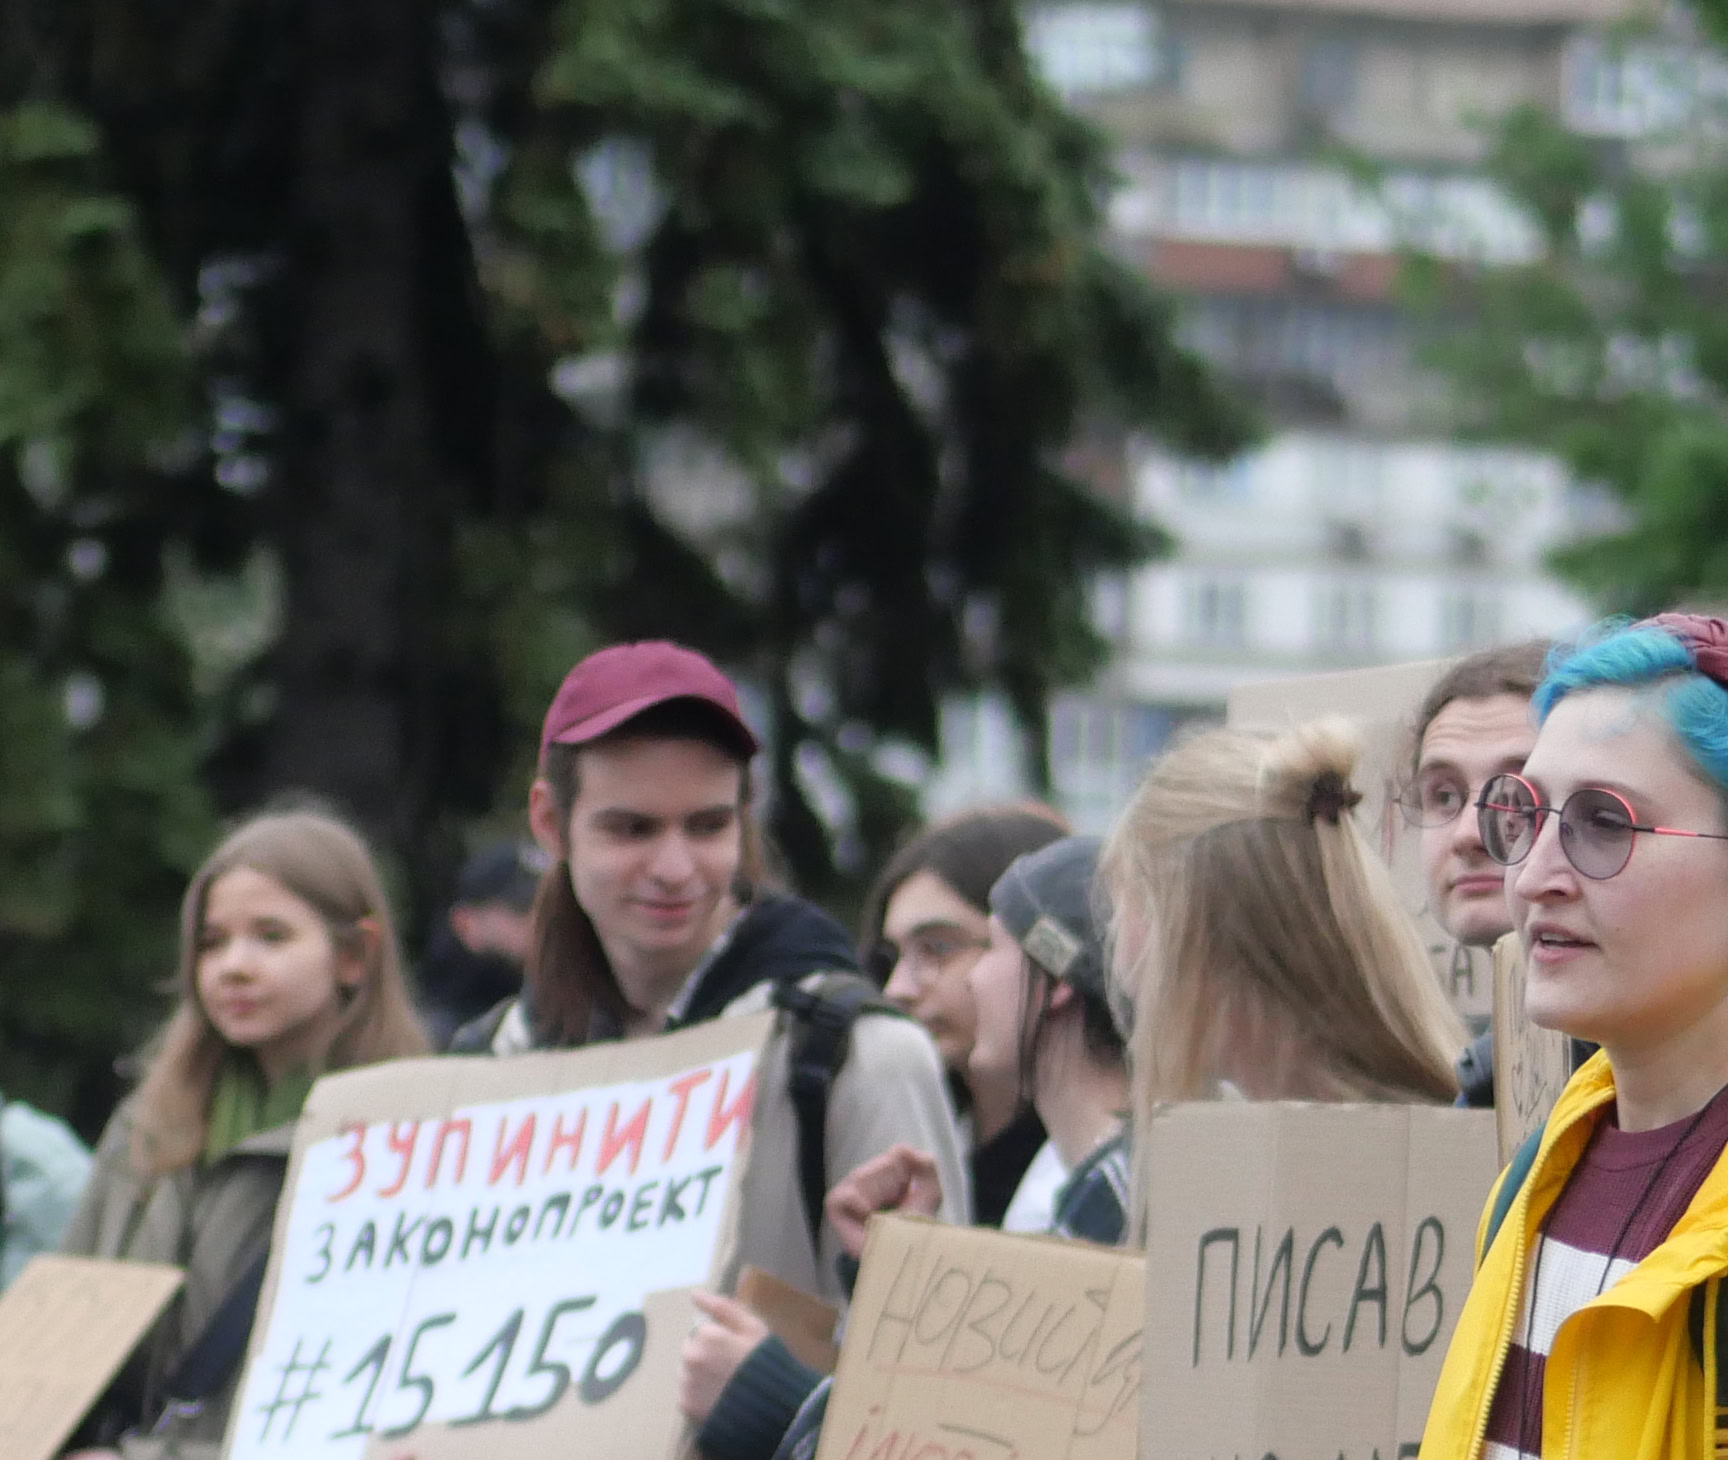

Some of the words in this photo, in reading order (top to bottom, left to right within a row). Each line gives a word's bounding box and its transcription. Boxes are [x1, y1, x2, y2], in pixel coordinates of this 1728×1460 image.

[325, 1066, 760, 1204] ЗУПИНИТИ
[303, 1164, 725, 1285] ЗАКОНОПРОЕКТ
[1191, 1214, 1447, 1368] ПИСАВ
[255, 1294, 649, 1443] #15150
[866, 1244, 1112, 1386] НОВИЙ
